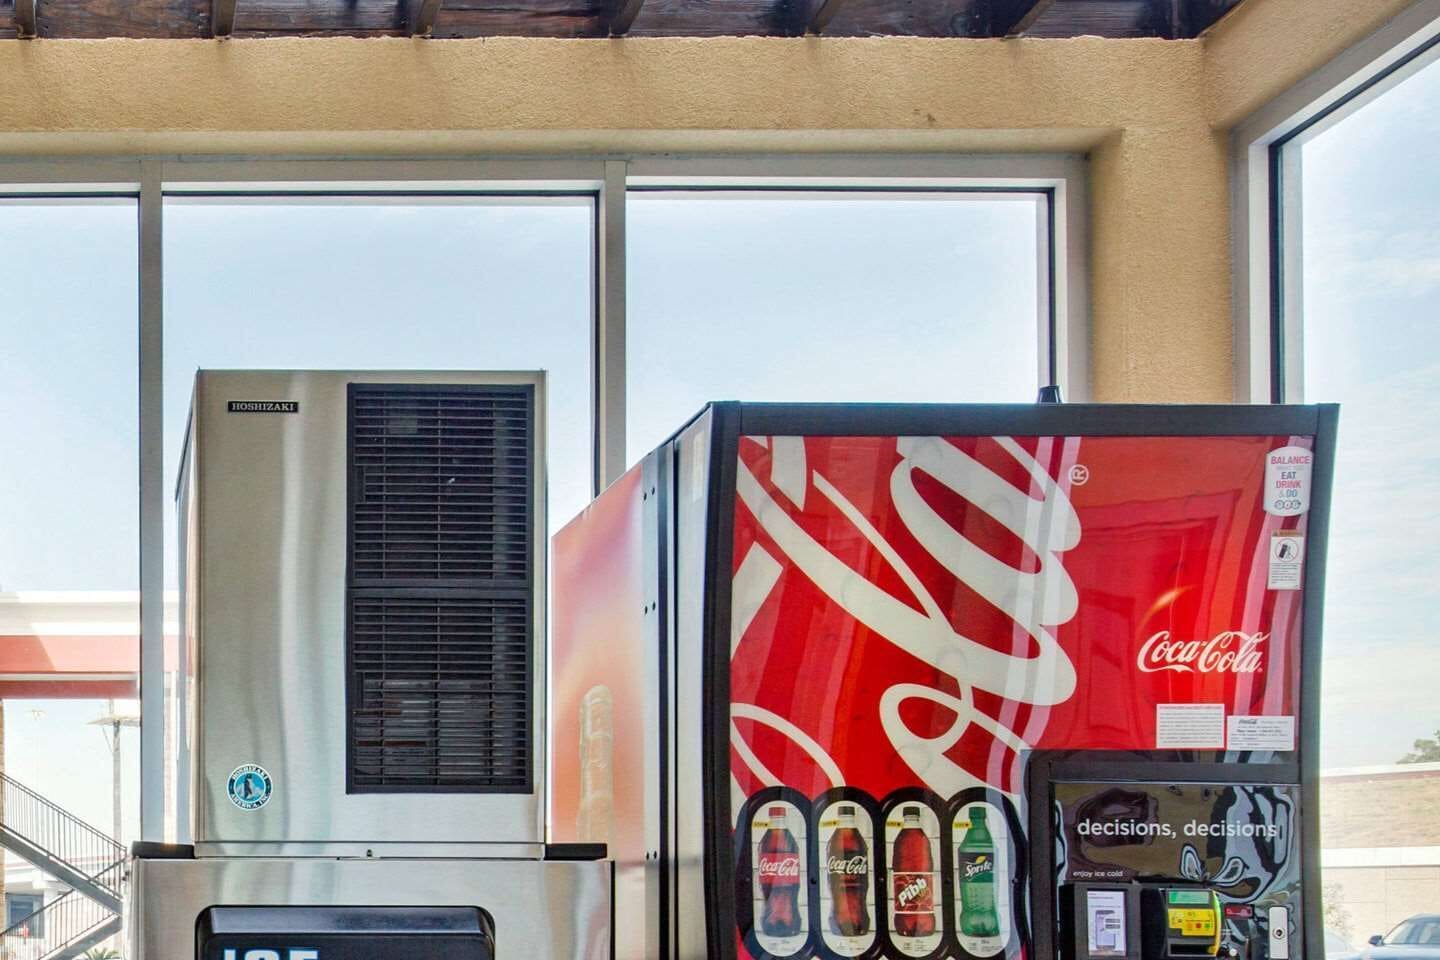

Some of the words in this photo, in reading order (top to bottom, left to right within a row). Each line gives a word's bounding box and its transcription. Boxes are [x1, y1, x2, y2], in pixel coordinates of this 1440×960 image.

[231, 402, 295, 411] HOSHIZAKI
[1270, 455, 1311, 464] BALANCE
[1275, 480, 1302, 489] DRINK
[1281, 471, 1297, 480] EAT
[1137, 630, 1271, 673] Coca-Cola
[1077, 818, 1177, 839] decisions,
[1183, 819, 1278, 838] decisions
[759, 857, 800, 876] Coca-Cola
[827, 855, 868, 874] Coca-Cola
[965, 860, 993, 877] Sprite
[898, 877, 928, 907] Pibb
